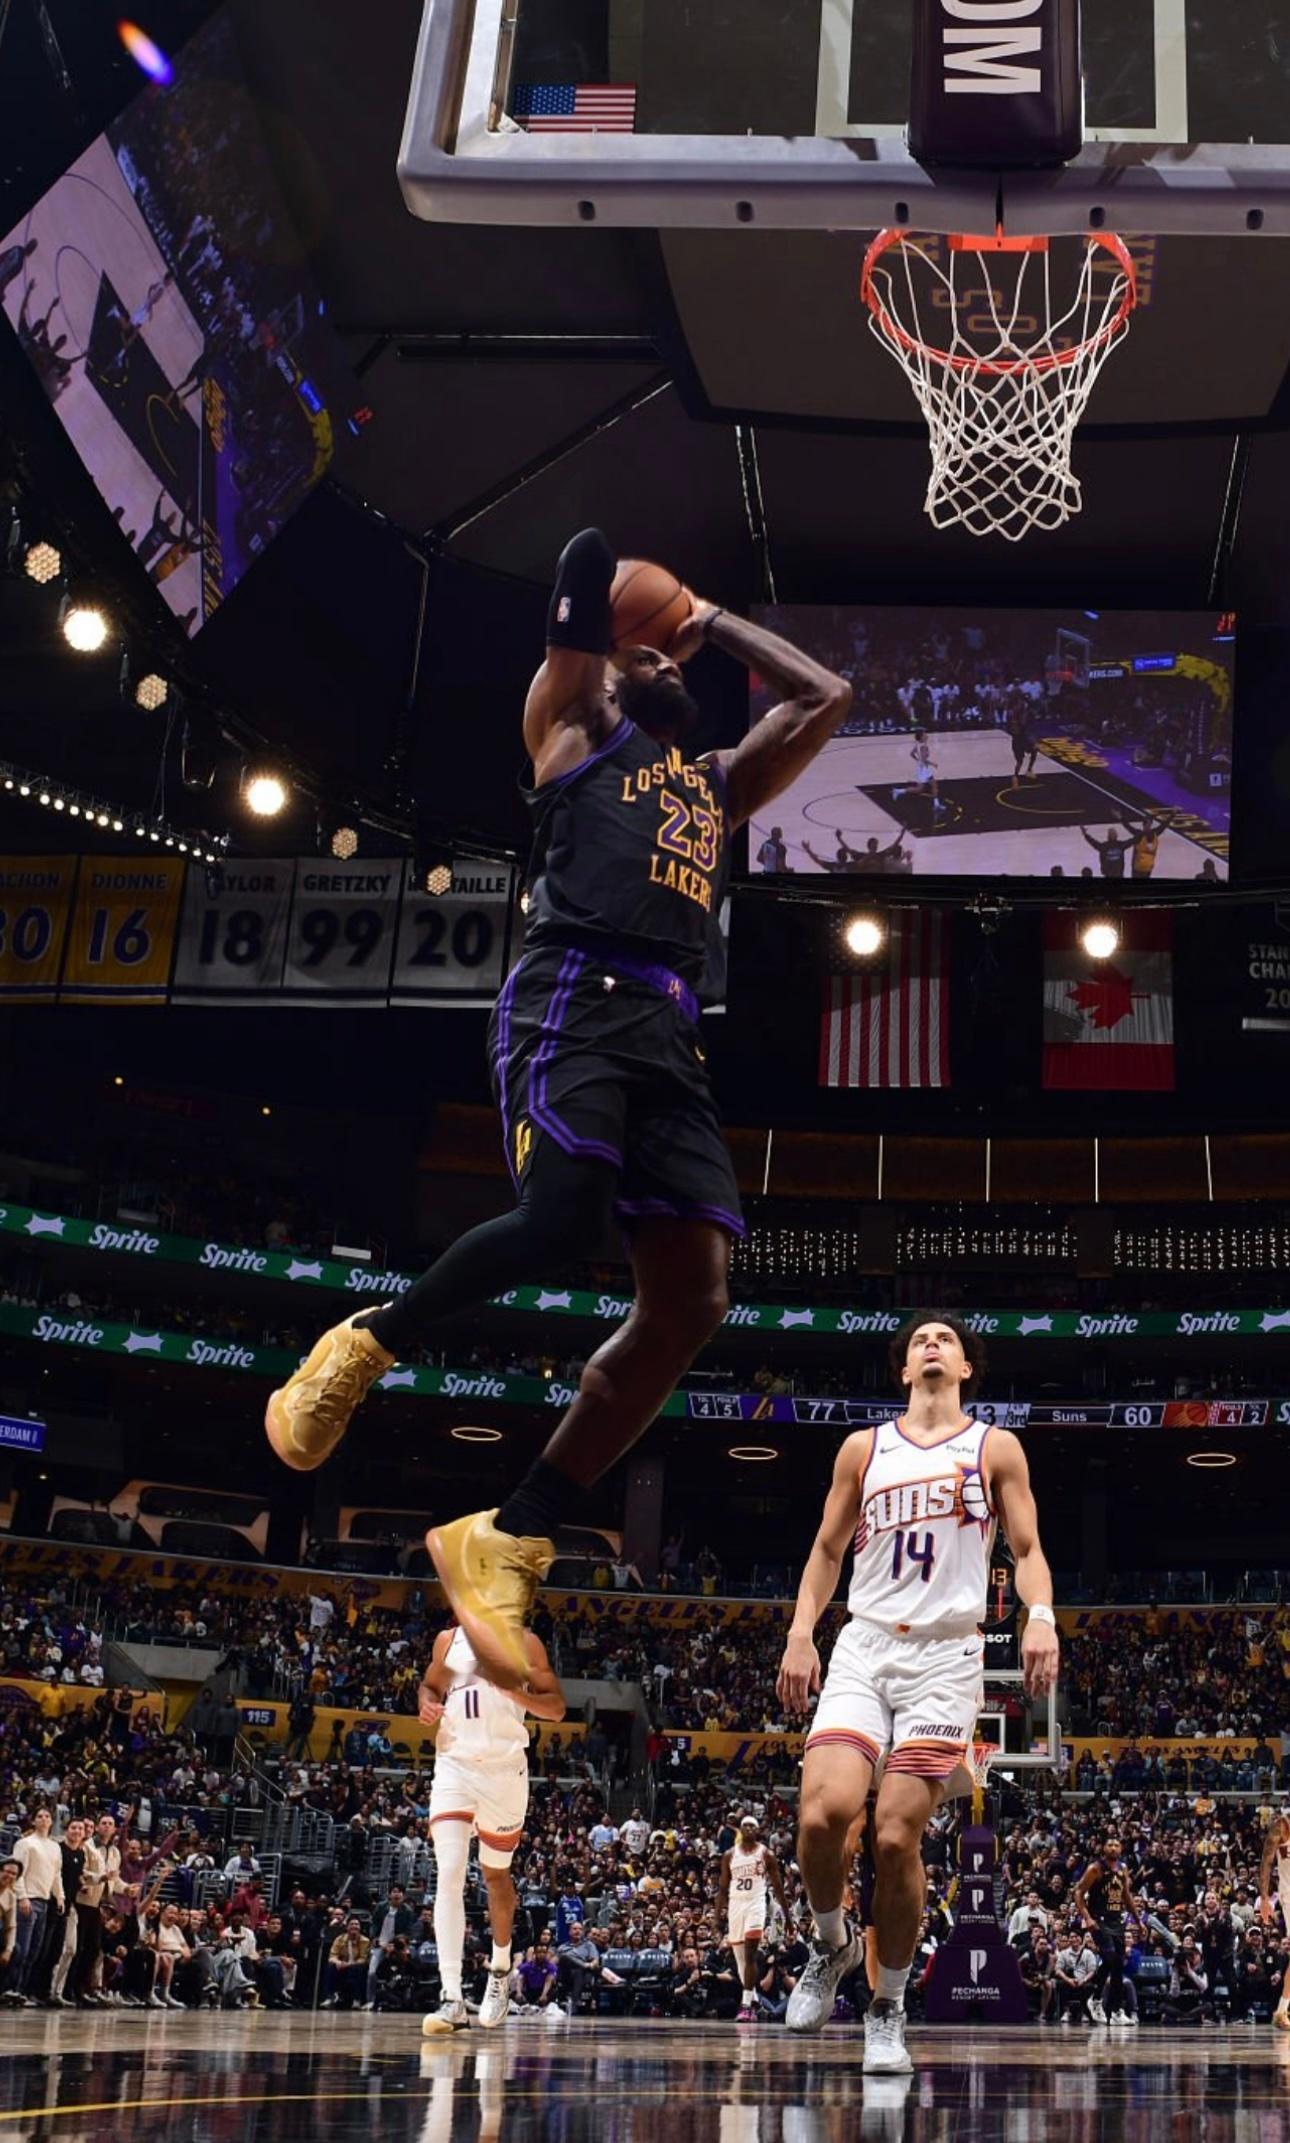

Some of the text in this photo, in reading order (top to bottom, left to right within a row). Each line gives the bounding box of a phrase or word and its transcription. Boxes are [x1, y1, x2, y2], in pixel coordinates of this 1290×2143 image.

[622, 763, 665, 802] LOS
[657, 788, 718, 872] 23
[91, 873, 169, 890] DIONNE
[303, 874, 392, 892] GRETZKY
[87, 907, 152, 966] 16
[200, 909, 265, 966] 18
[301, 908, 384, 967] 99
[407, 909, 494, 968] 20
[88, 1224, 160, 1254] Sprite
[199, 1243, 268, 1272] Sprite
[344, 1268, 413, 1294] Sprite
[721, 1305, 761, 1326] rite
[836, 1311, 901, 1334] Sprite
[1075, 1314, 1139, 1338] Sprite
[1176, 1311, 1241, 1336] Sprite
[32, 1316, 105, 1345] Sprite
[186, 1340, 256, 1368] Sprite
[439, 1373, 507, 1398] Sprite
[700, 1404, 710, 1416] 4
[723, 1404, 733, 1417] 5
[808, 1402, 835, 1421] 77
[966, 1404, 997, 1425] 13
[1052, 1410, 1088, 1423] Suns
[1124, 1406, 1151, 1426] 60
[1226, 1412, 1236, 1424] 4
[1250, 1412, 1260, 1425] 2
[891, 1529, 935, 1583] 14
[992, 1568, 1008, 1586] 13
[465, 1689, 479, 1719] 11
[247, 1710, 271, 1724] 115
[908, 1723, 964, 1739] PHOENIX
[736, 1878, 753, 1891] 20
[952, 1986, 1000, 1995] PECHANGA
